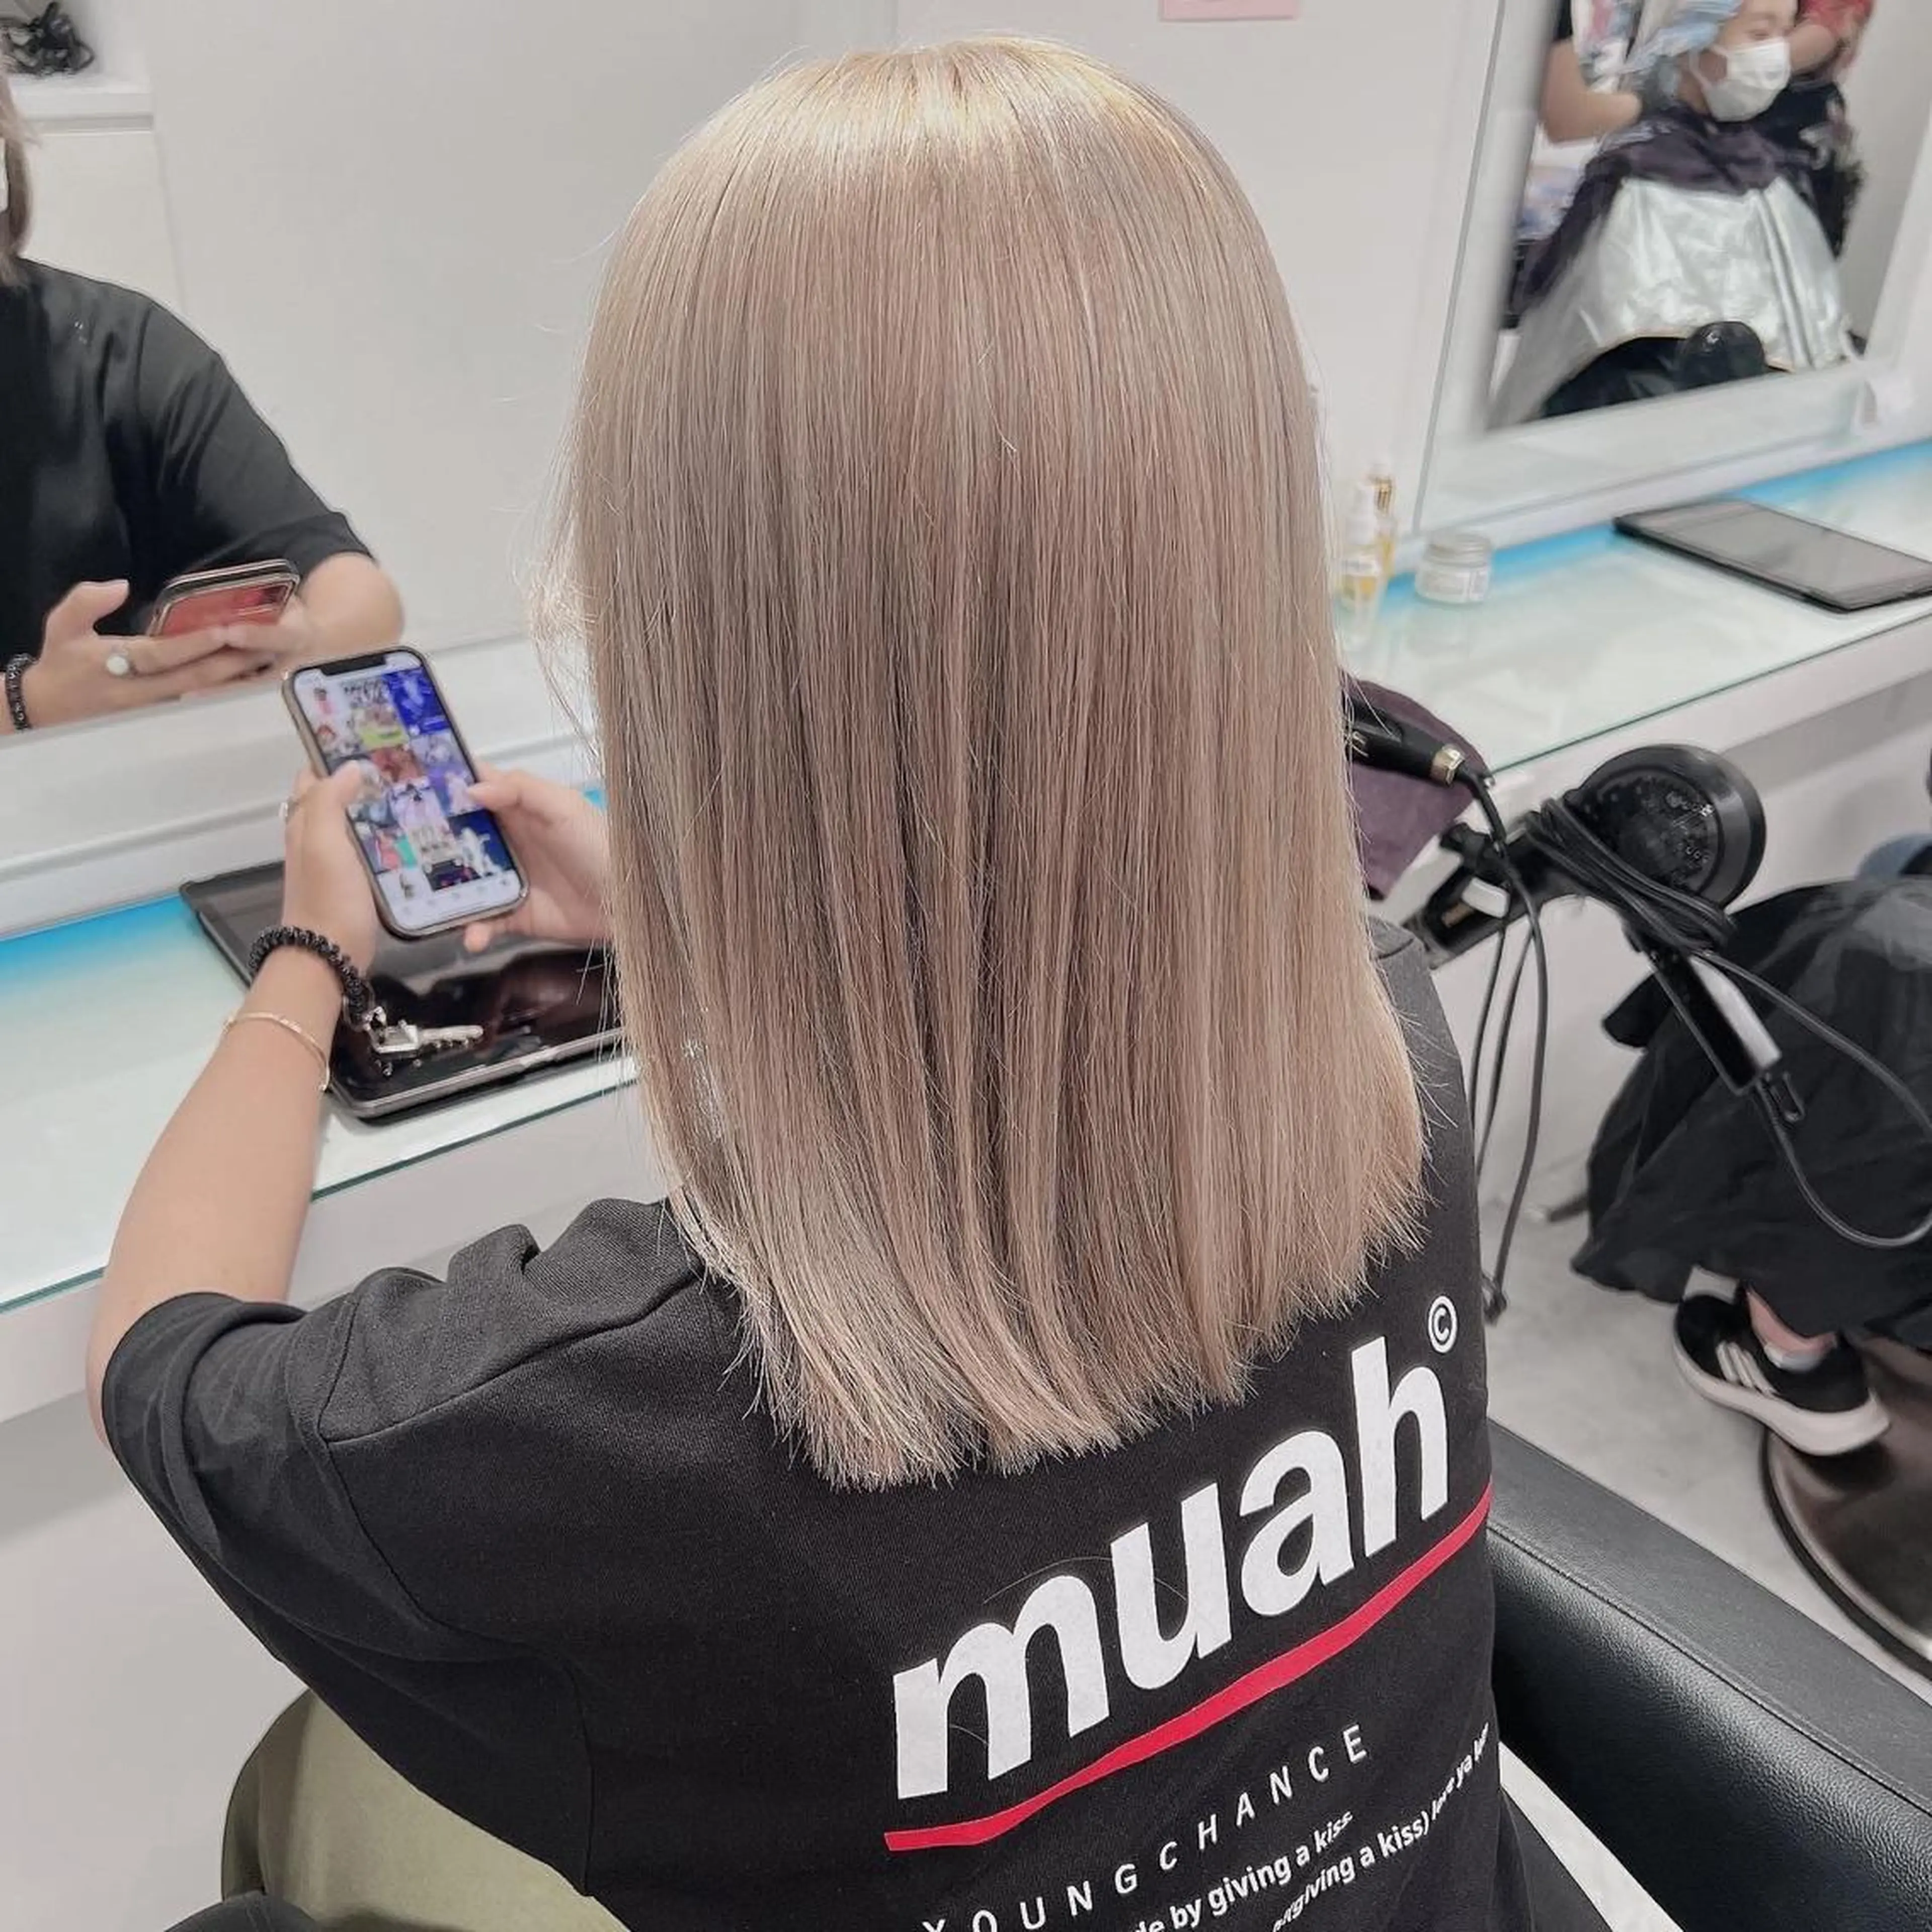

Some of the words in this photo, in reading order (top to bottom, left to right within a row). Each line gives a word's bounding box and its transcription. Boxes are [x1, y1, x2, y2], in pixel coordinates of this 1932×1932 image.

[893, 1336, 1448, 1799] muah
[1359, 1845, 1376, 1868] a
[1377, 1810, 1430, 1858] kiss)
[1169, 1898, 1201, 1930] by
[1208, 1856, 1292, 1916] giving
[1296, 1845, 1310, 1867] a
